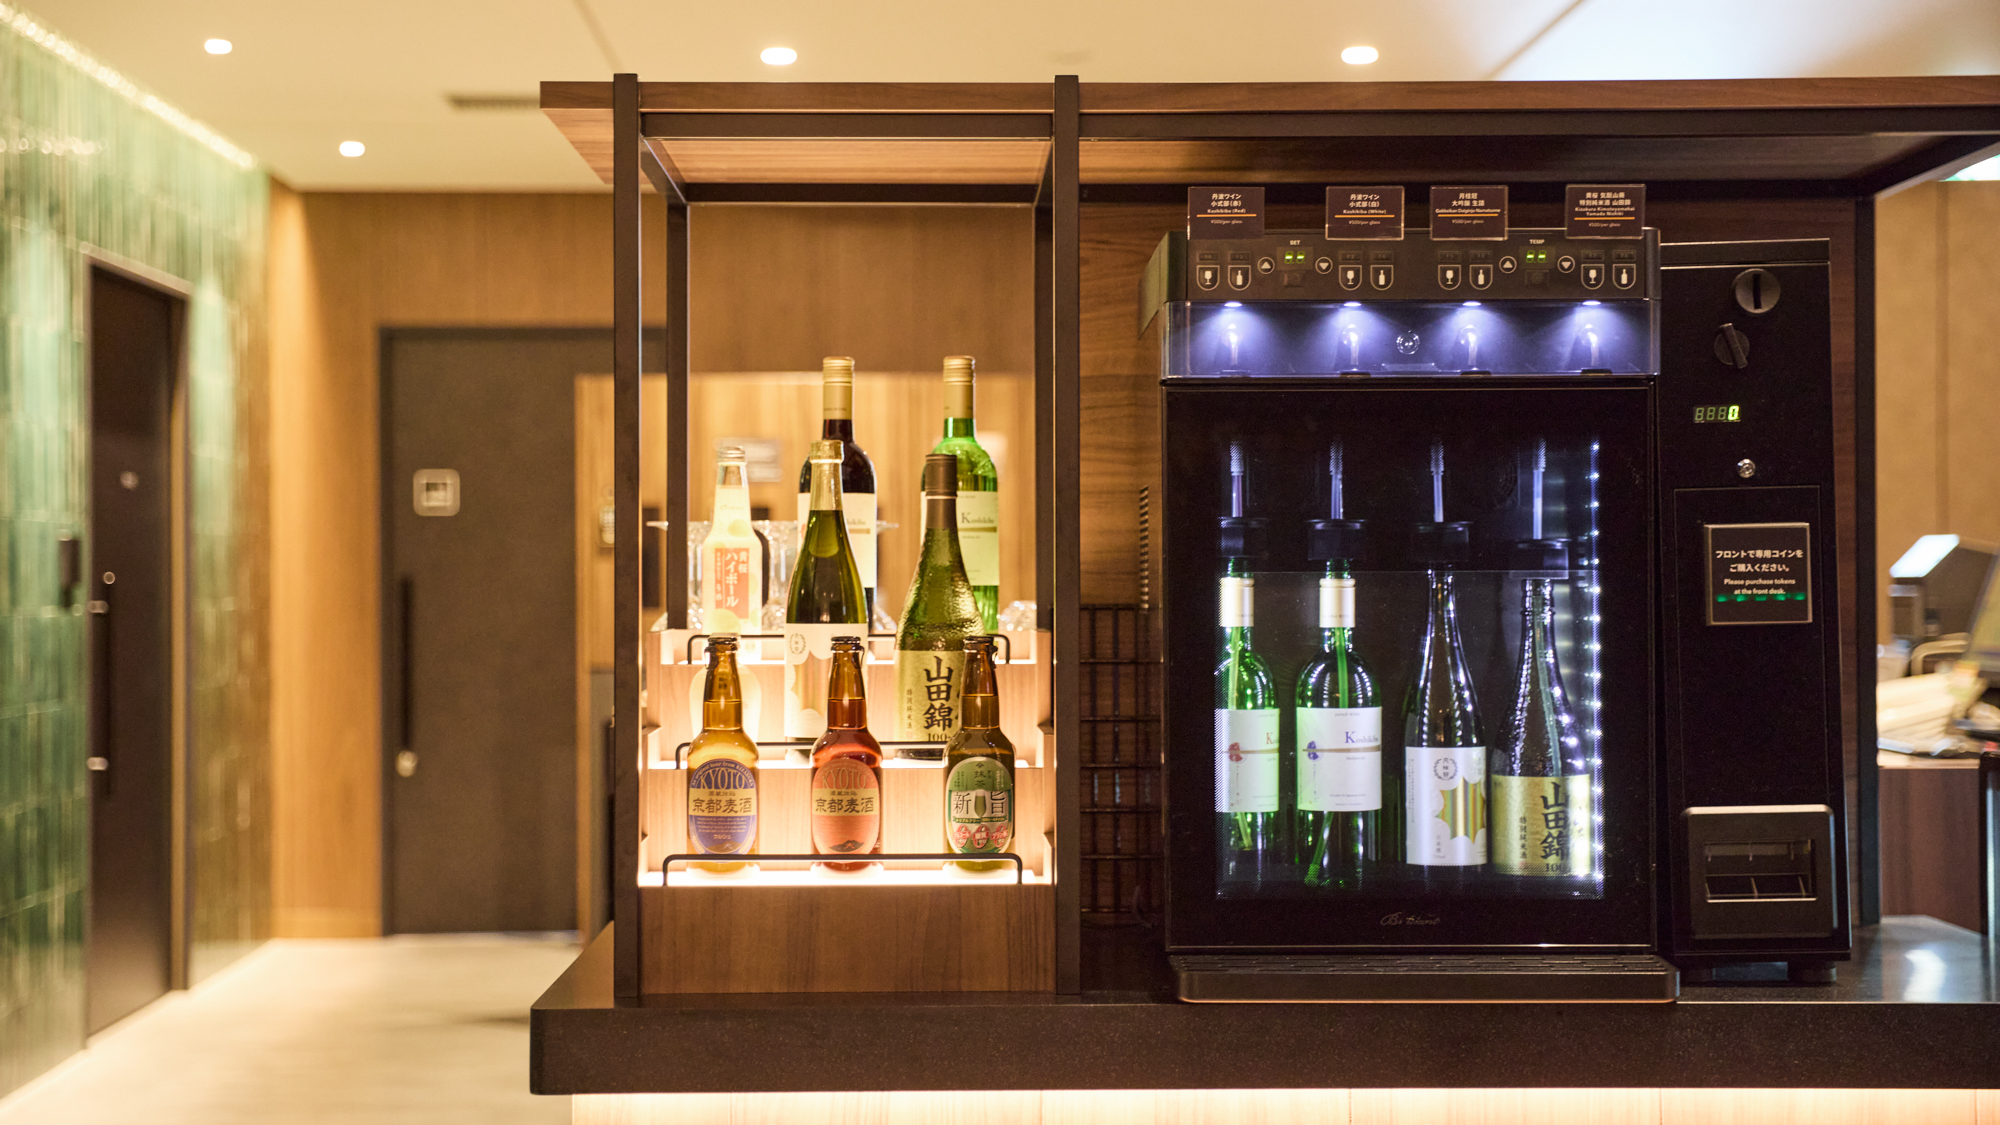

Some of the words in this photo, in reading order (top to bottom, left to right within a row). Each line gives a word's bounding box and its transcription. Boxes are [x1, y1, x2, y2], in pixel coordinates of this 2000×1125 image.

[1715, 550, 1803, 559] フロントで専用コインを
[1730, 563, 1789, 572] ご購入ください。
[726, 552, 739, 607] ハイボール
[923, 656, 954, 732] 山田錦
[700, 768, 745, 790] KYOTO
[822, 768, 867, 790] KYOTO
[692, 797, 752, 813] 京都麦酒
[815, 797, 874, 813] 京都麦酒
[953, 791, 971, 814] 新
[990, 791, 1005, 814] 旨
[1540, 782, 1570, 861] 山田錦
